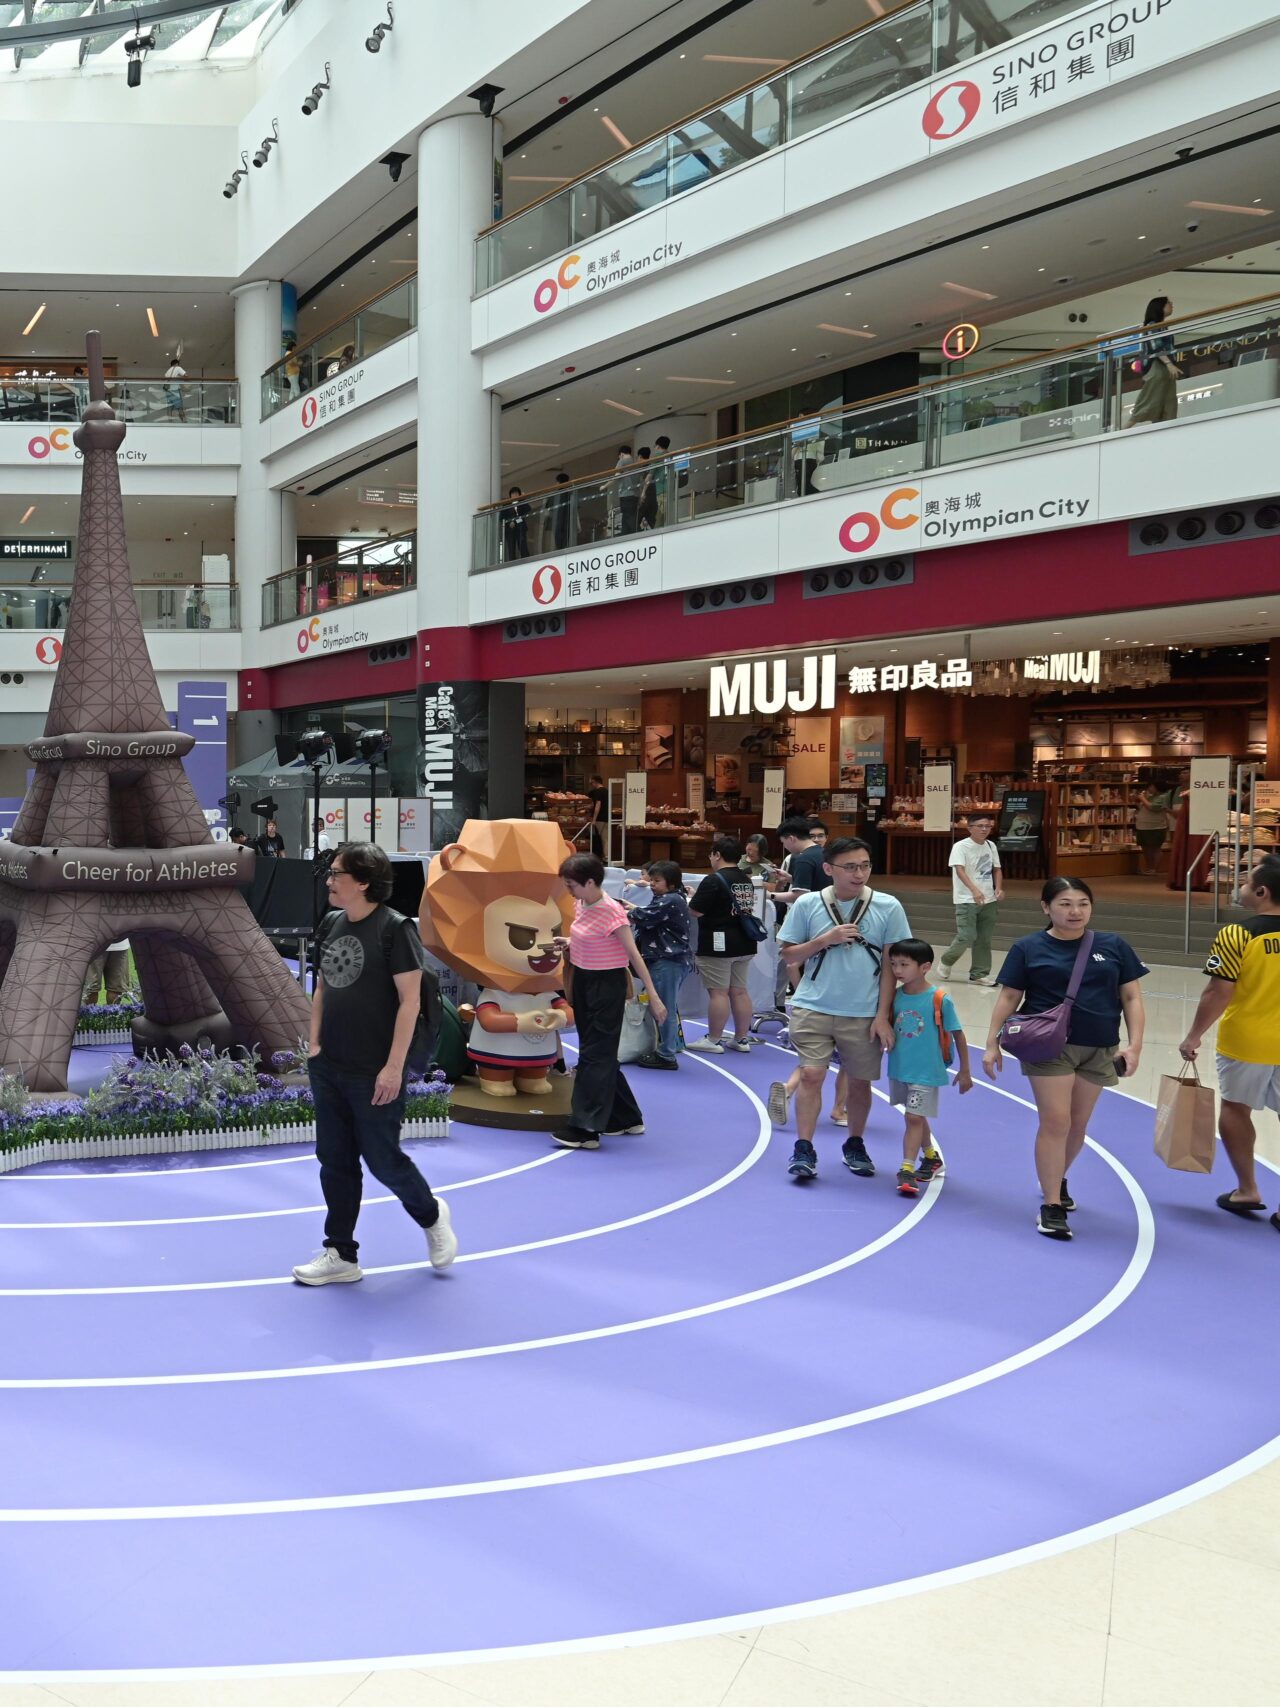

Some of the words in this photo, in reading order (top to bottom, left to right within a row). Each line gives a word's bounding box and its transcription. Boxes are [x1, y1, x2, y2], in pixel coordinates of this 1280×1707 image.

[992, 43, 1057, 84] SINO
[1066, 0, 1175, 51] GROUP
[992, 34, 1135, 115] 信和集團
[586, 250, 621, 276] 奧海城
[586, 256, 651, 292] Olympian
[652, 241, 683, 262] City
[320, 385, 337, 403] SINO
[337, 369, 365, 392] GROUP
[320, 388, 356, 418] 信和集團
[126, 450, 147, 461] City
[924, 492, 982, 517] 奧海城
[924, 507, 1034, 538] Olympian
[1039, 498, 1090, 518] City
[4, 543, 67, 556] DETERMINANT
[567, 557, 601, 576] SINO
[605, 546, 657, 568] GROUP
[568, 568, 639, 597] 信和集團
[322, 635, 354, 649] Olympian
[354, 631, 369, 643] City
[1024, 660, 1048, 680] Meal
[1049, 650, 1101, 684] MUJI
[709, 654, 836, 717] MUJI
[848, 658, 972, 694] 無印良品
[425, 696, 437, 731] Meal
[28, 745, 42, 759] Sino
[86, 740, 122, 756] Sino
[127, 742, 176, 757] Group
[792, 743, 826, 753] SALE
[424, 733, 453, 809] MUJI
[1194, 781, 1225, 789] SALE
[766, 786, 782, 794] SALE
[62, 860, 120, 882] Cheer
[125, 862, 153, 882] for
[156, 860, 238, 882] Athletes
